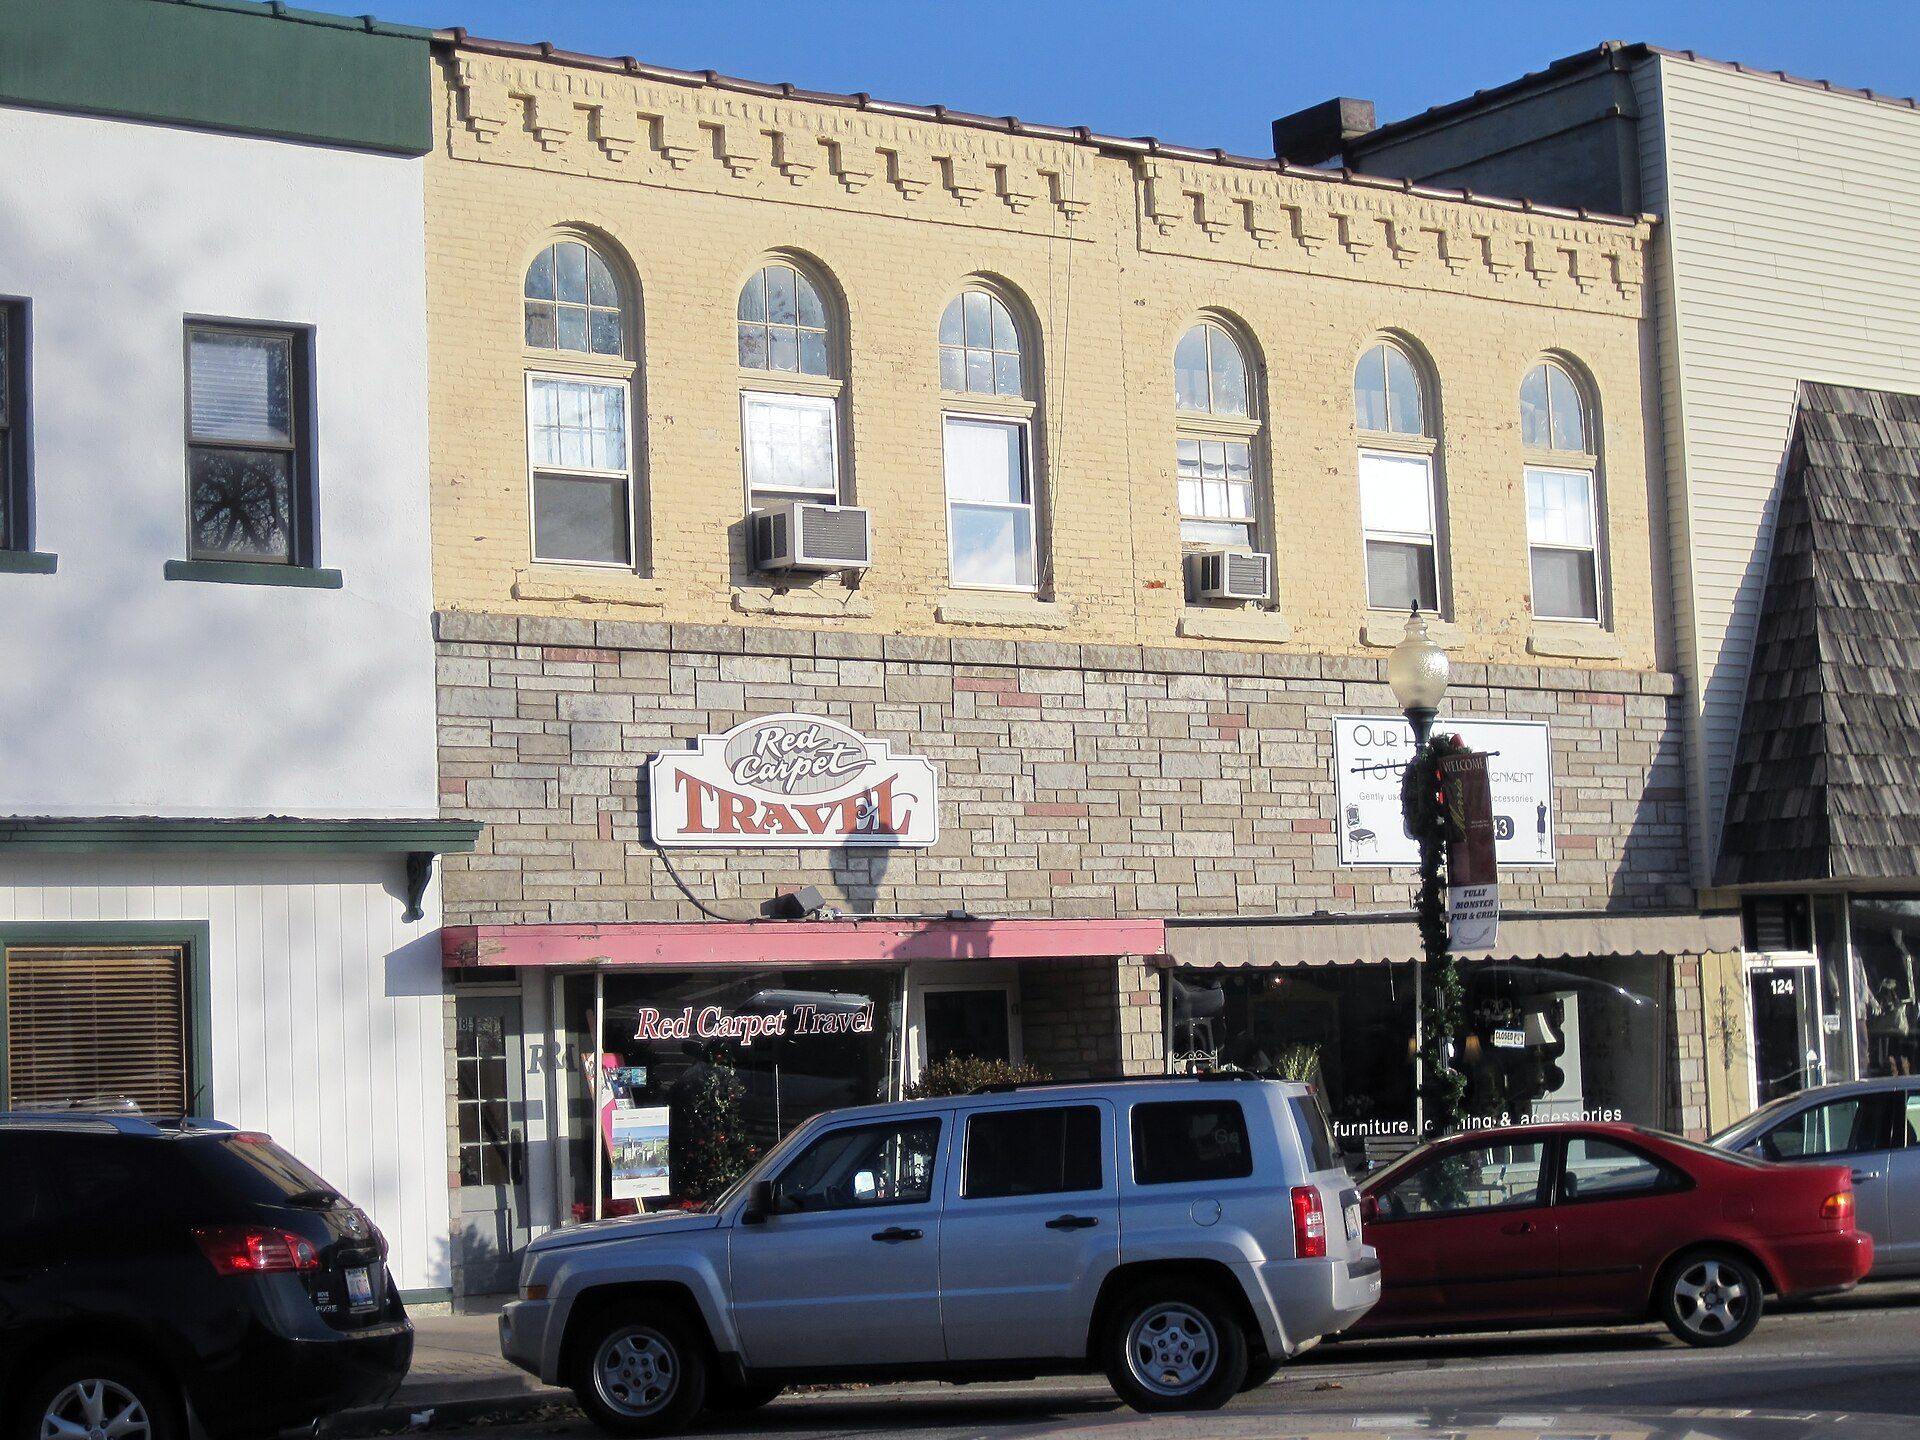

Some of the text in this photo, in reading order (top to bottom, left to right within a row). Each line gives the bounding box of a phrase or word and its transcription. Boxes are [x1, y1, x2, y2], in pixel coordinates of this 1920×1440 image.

[754, 724, 831, 760] Red
[733, 743, 876, 794] Carpet
[1442, 757, 1486, 772] WELCOME
[674, 767, 919, 835] TRAVEL
[1359, 791, 1385, 802] Gently
[1491, 794, 1534, 803] ccessories
[1463, 888, 1488, 898] TULLY
[1455, 899, 1494, 909] MONSTER
[1451, 912, 1468, 921] PUB
[1468, 912, 1475, 920] &
[1770, 978, 1794, 995] 124
[634, 1002, 875, 1046] Red Carpet Travel
[1495, 1031, 1514, 1041] CLOSED
[1333, 1118, 1416, 1138] furniture,
[1500, 1111, 1512, 1127] &
[1520, 1106, 1622, 1126] accessories
